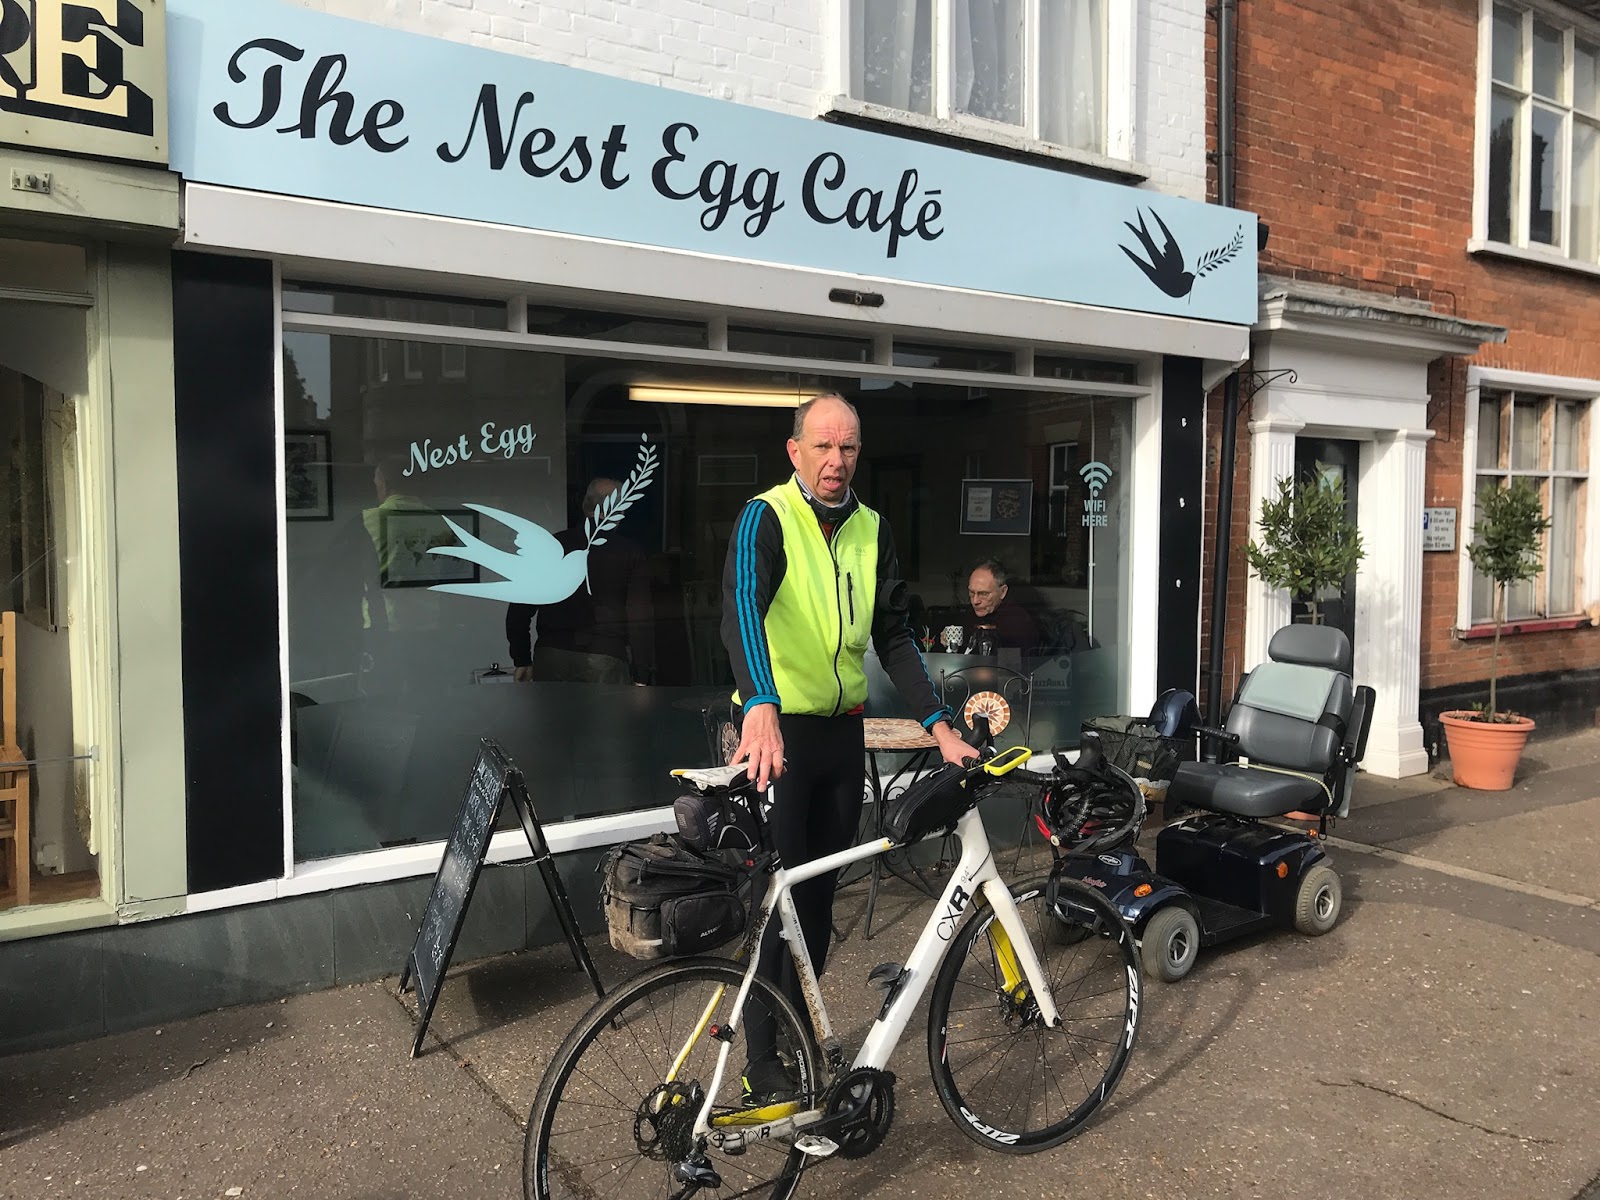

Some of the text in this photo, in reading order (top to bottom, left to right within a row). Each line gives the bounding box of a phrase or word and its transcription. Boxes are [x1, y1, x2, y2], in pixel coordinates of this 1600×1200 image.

[212, 38, 944, 259] The Nest Egg Café
[402, 421, 537, 477] Nest Egg
[1082, 515, 1108, 527] HERE
[1083, 499, 1106, 512] WIFI
[936, 885, 970, 941] CXR
[1126, 964, 1139, 1050] ZIPP
[959, 1105, 1021, 1145] ZIPP
